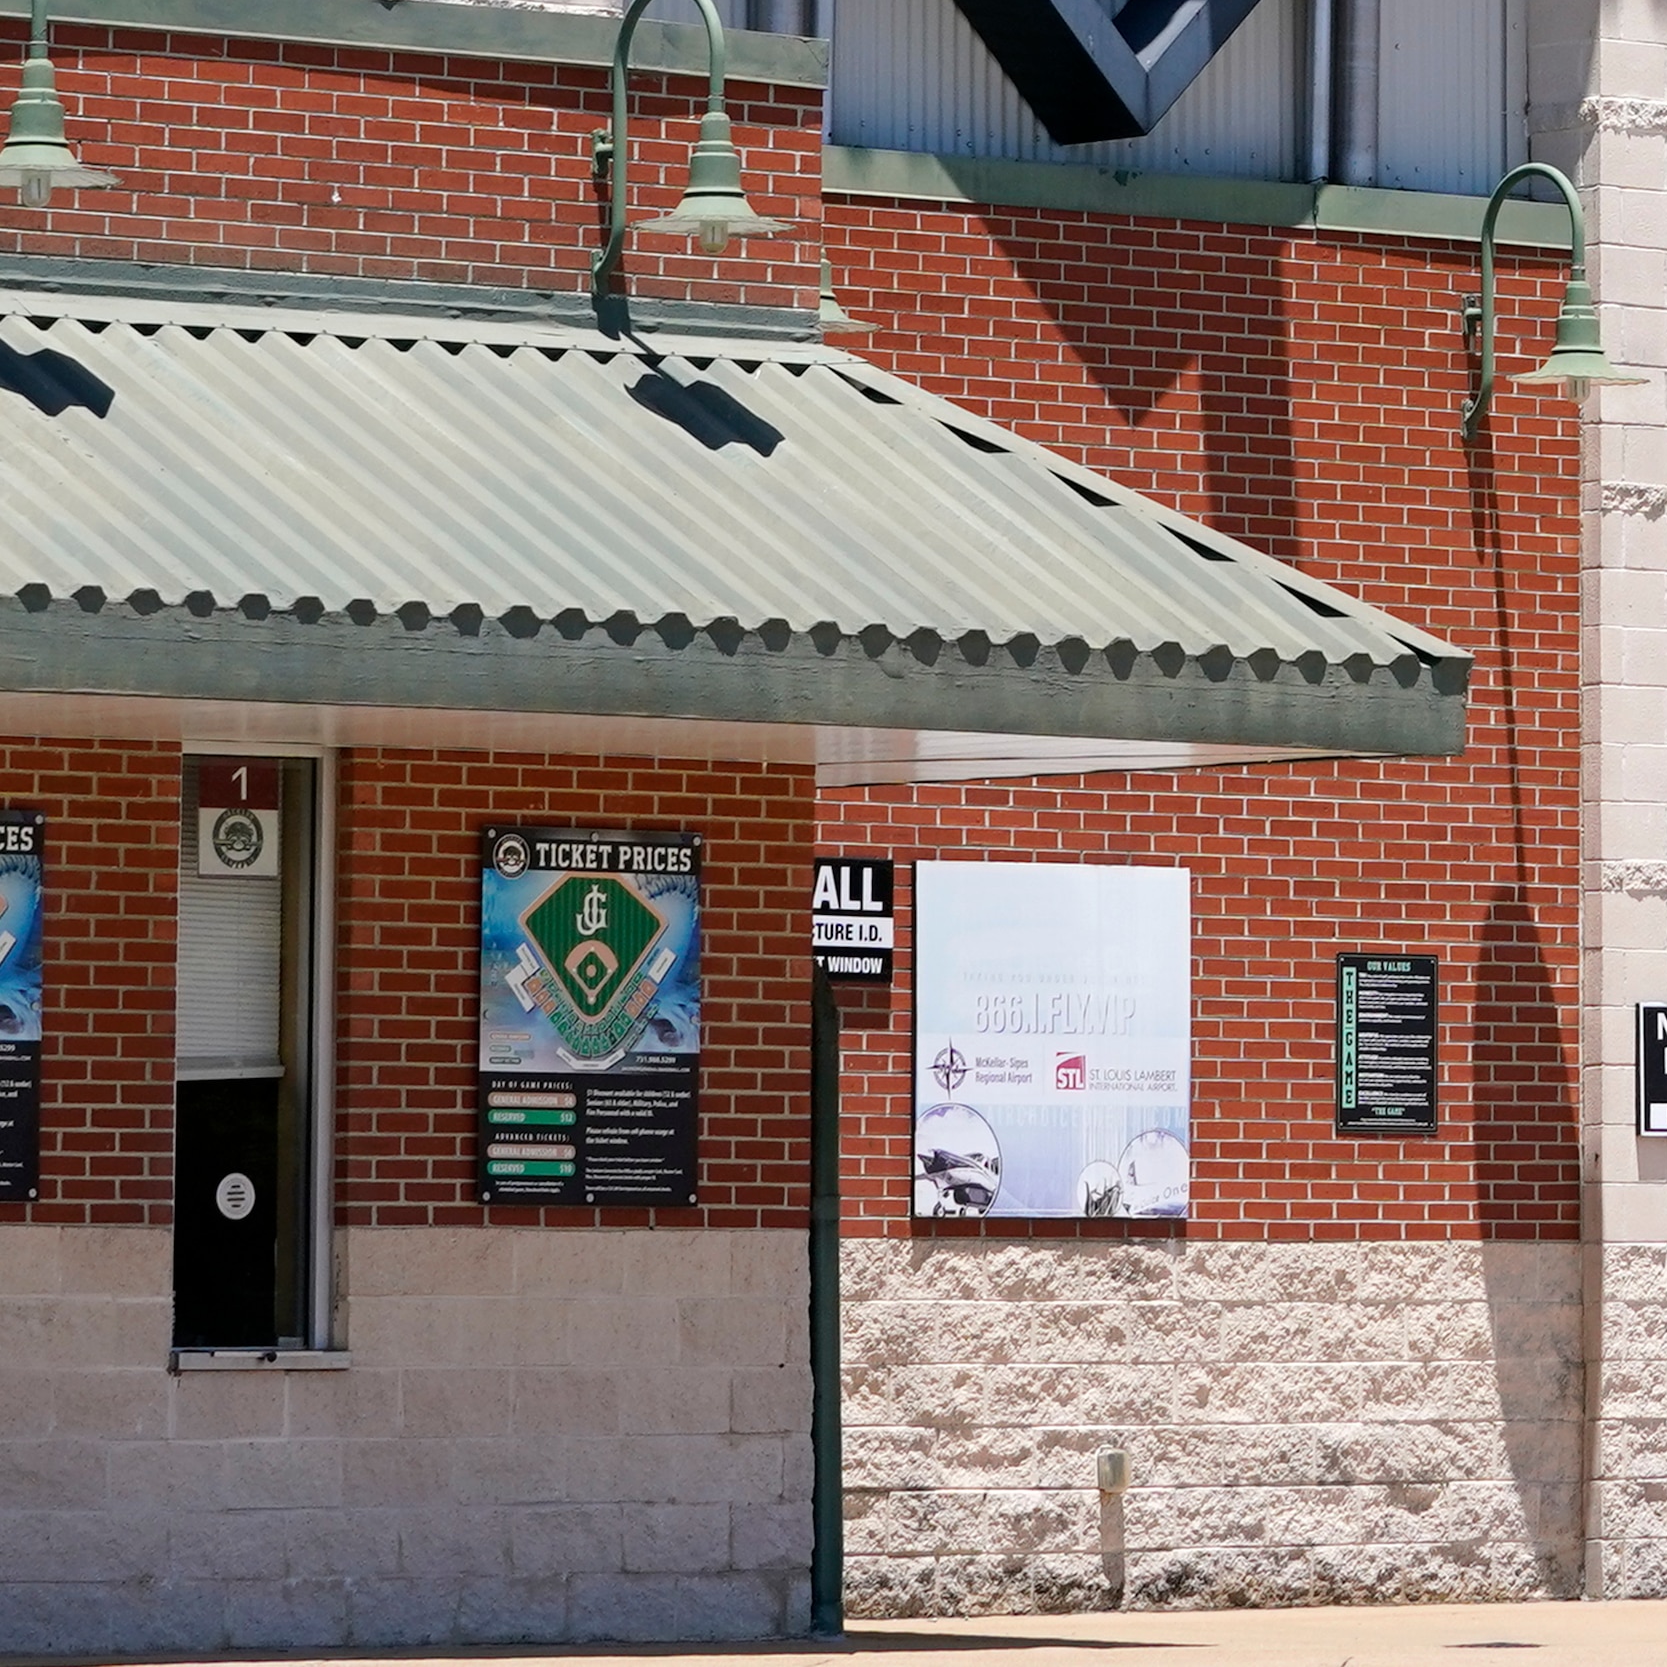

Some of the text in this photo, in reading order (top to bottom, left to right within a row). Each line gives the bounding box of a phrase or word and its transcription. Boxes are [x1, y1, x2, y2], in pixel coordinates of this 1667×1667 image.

[231, 766, 247, 802] 1
[535, 843, 692, 872] TICKET PRICES
[812, 923, 882, 942] TURE I.D.
[827, 956, 883, 974] WINDOW
[1367, 961, 1411, 972] OUR VALUES
[975, 1072, 1033, 1085] Regional Airport
[1057, 1068, 1085, 1089] STL
[1102, 1069, 1132, 1082] LOUIS
[1134, 1070, 1176, 1083] LAMBERT
[1163, 1183, 1188, 1200] One
